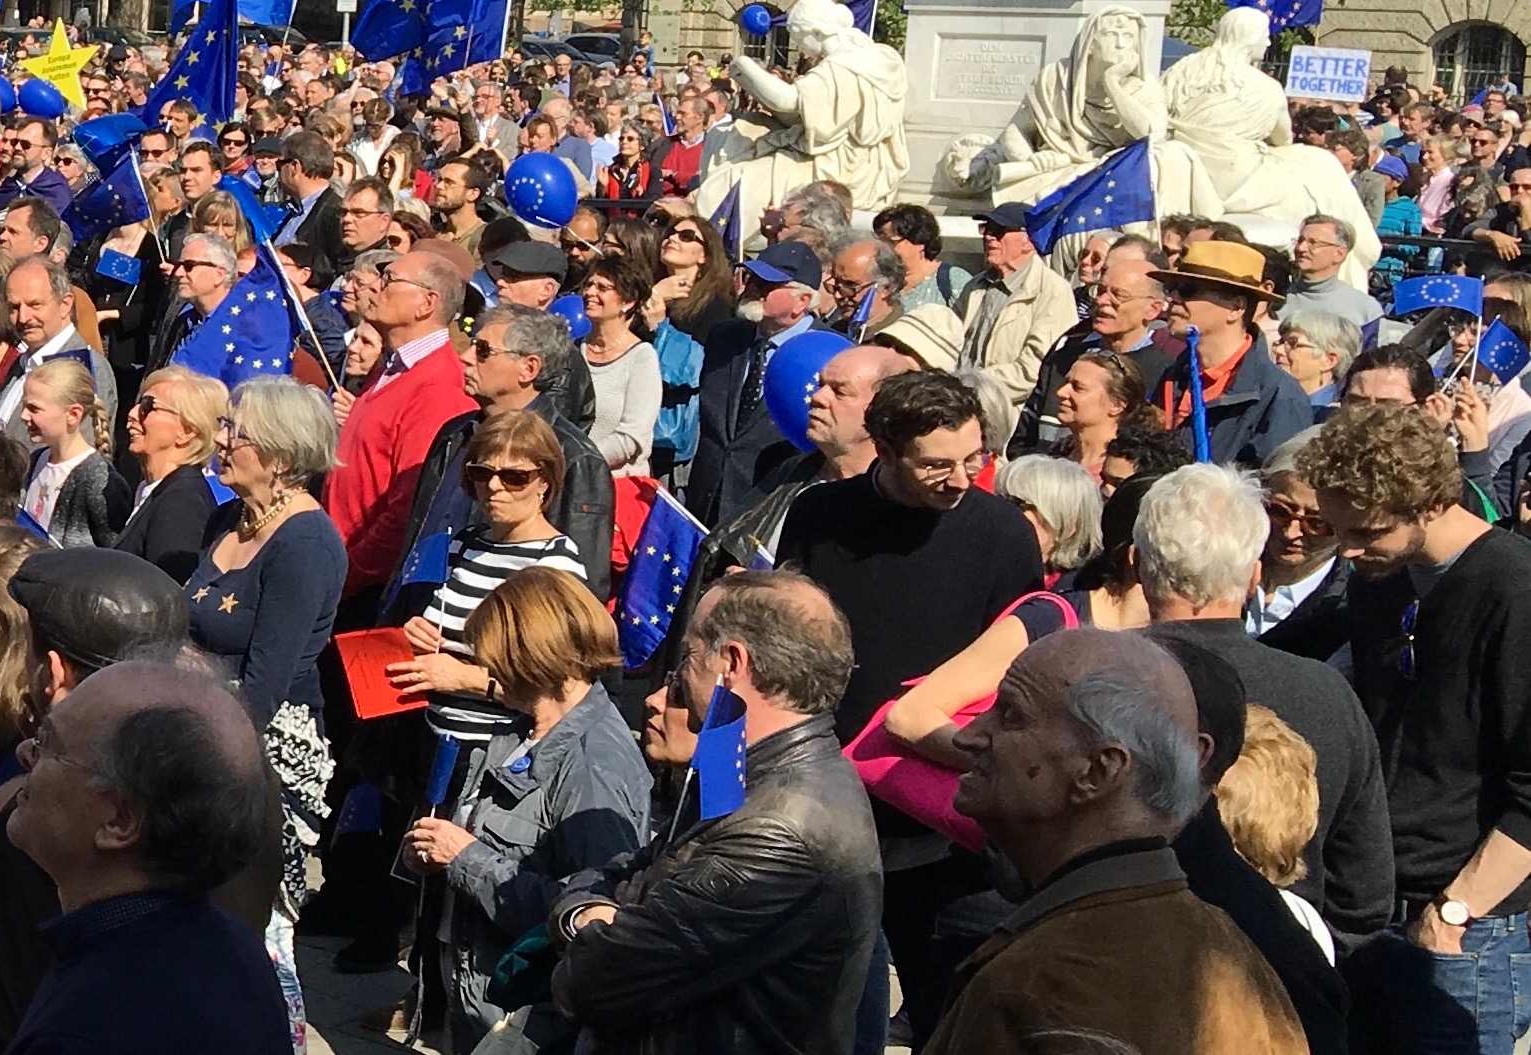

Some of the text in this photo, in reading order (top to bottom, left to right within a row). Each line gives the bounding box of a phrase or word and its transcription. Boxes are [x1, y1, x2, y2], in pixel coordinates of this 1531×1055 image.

[47, 54, 71, 64] Europa
[1292, 55, 1368, 79] BETTER
[1290, 75, 1366, 96] TOGETHER
